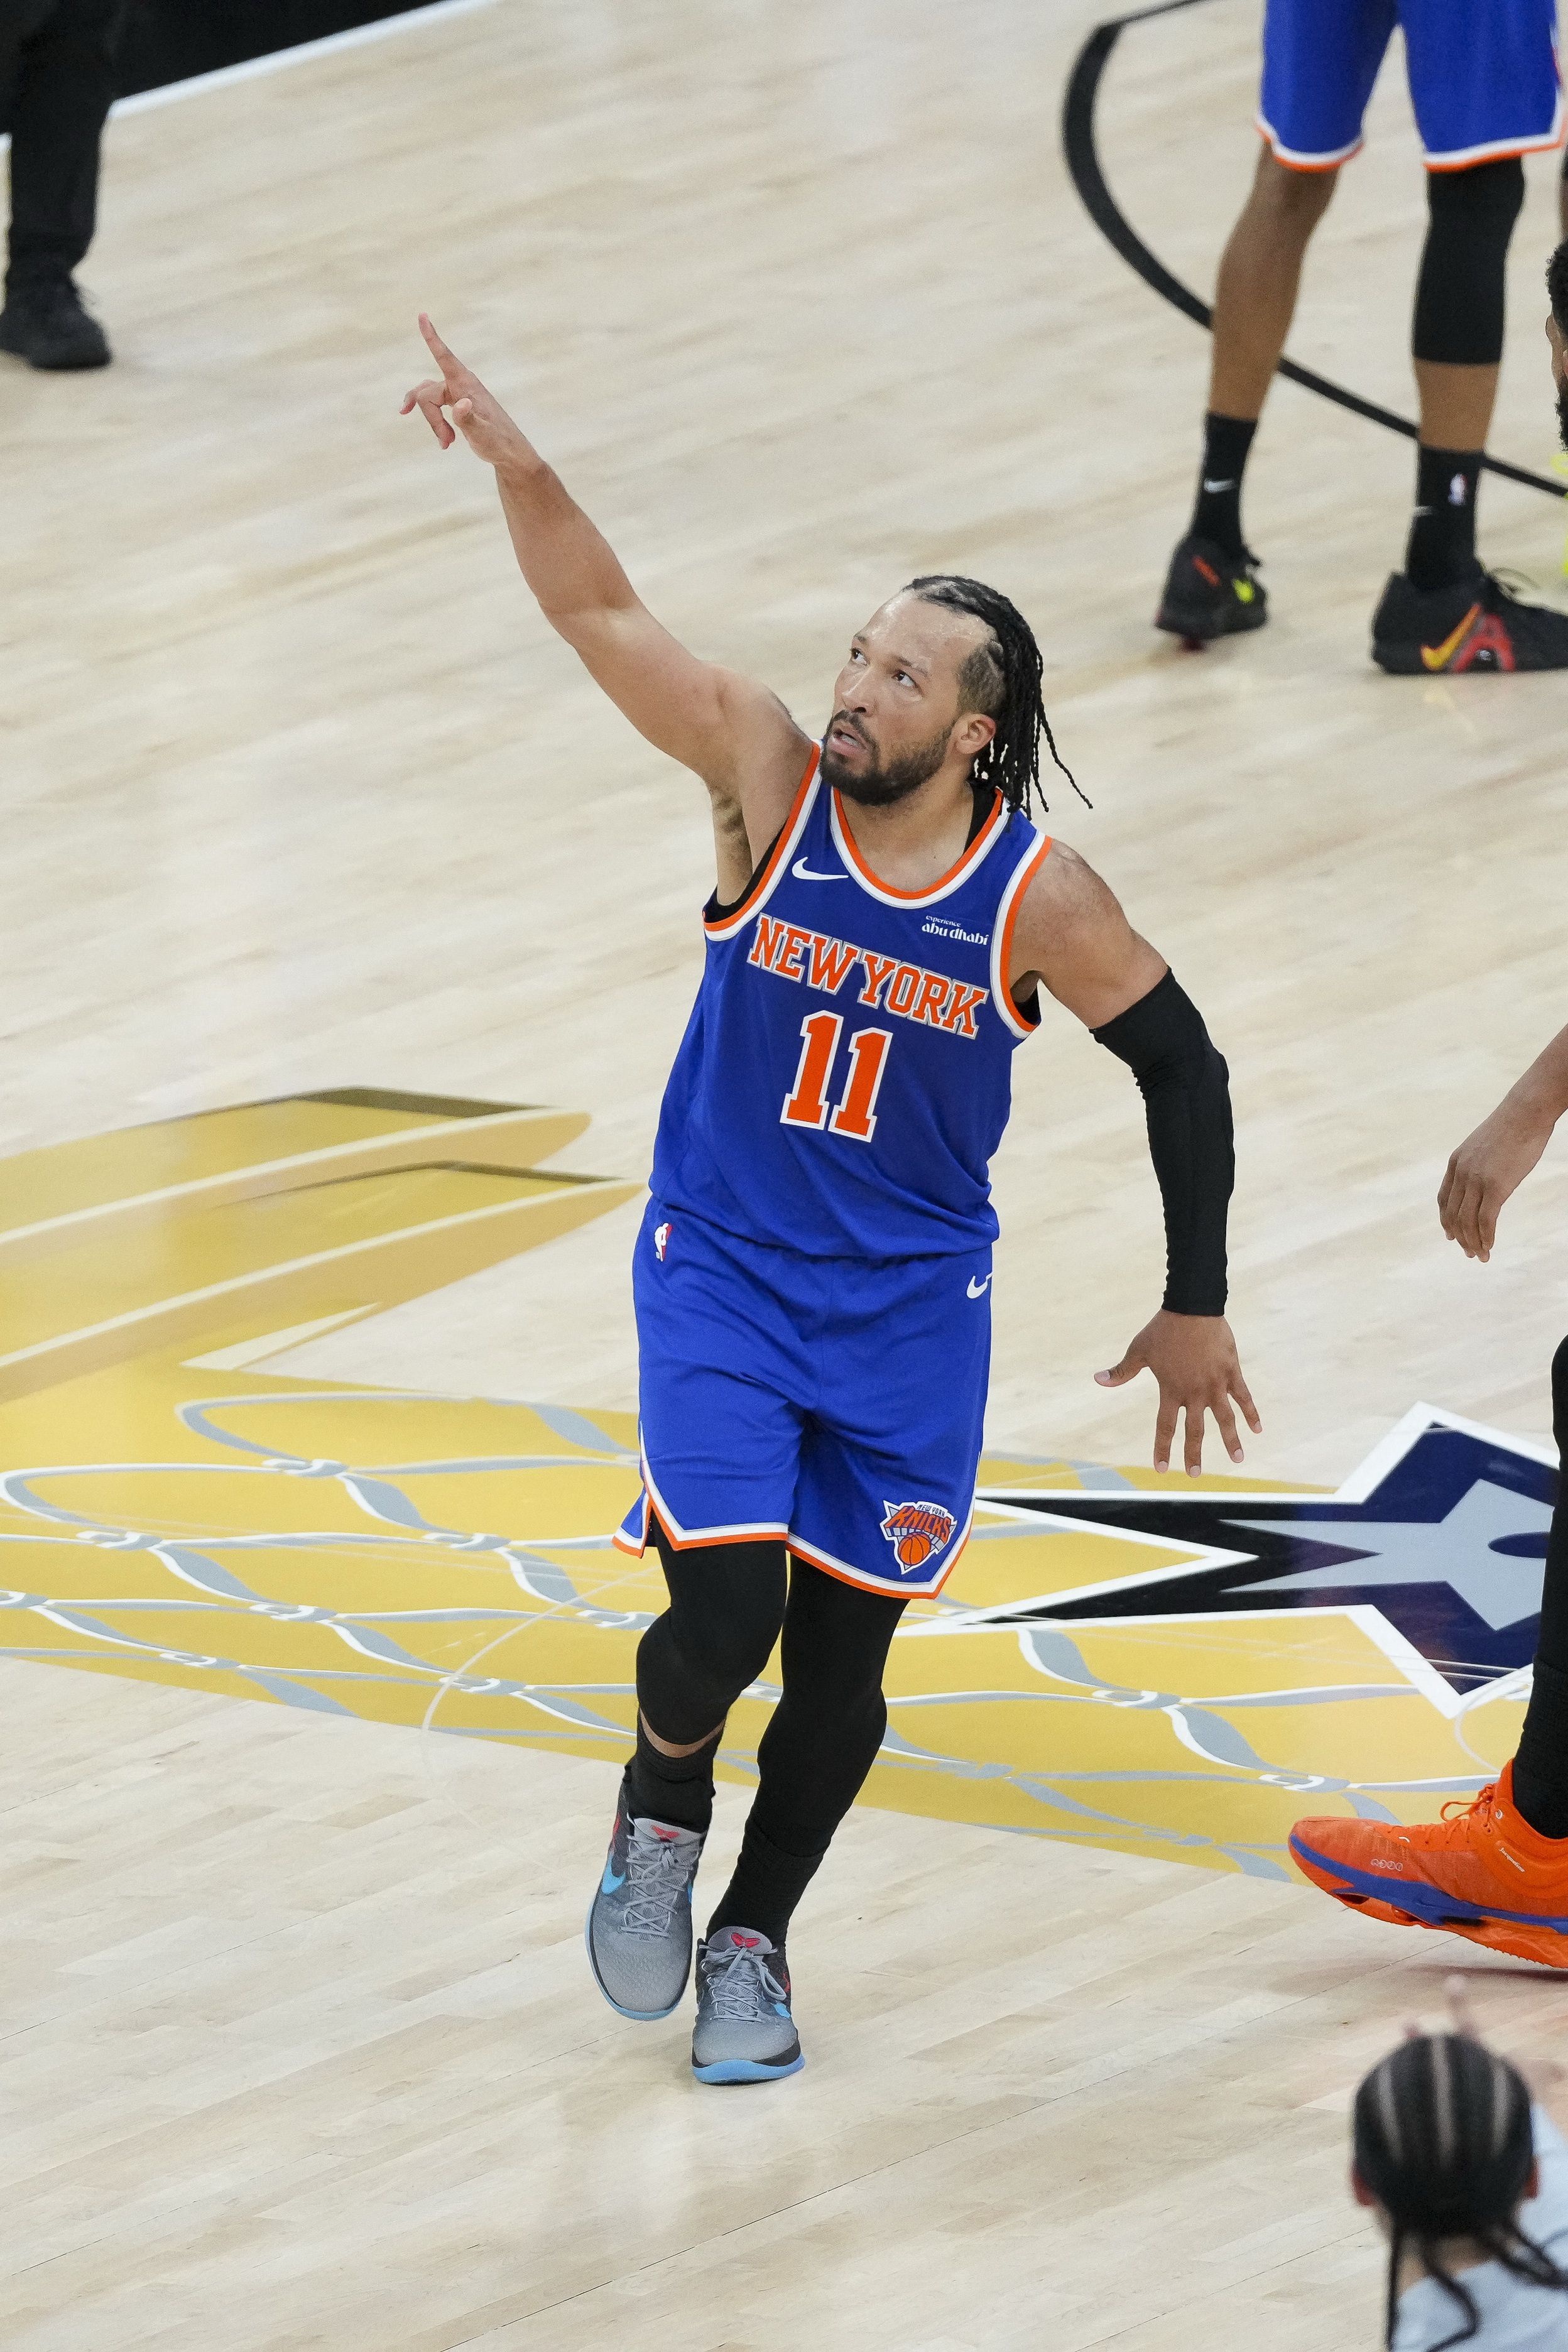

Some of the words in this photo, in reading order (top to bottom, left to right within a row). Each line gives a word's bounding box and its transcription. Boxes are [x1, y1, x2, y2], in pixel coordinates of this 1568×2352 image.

[922, 923, 948, 937] abu
[949, 928, 989, 945] dhabi
[925, 915, 961, 927] experience
[747, 912, 861, 995] NEW
[857, 948, 989, 1040] YORK
[780, 1010, 893, 1142] 11
[884, 1506, 951, 1544] KNICKS
[917, 1504, 932, 1512] NEW
[932, 1506, 945, 1518] YORK
